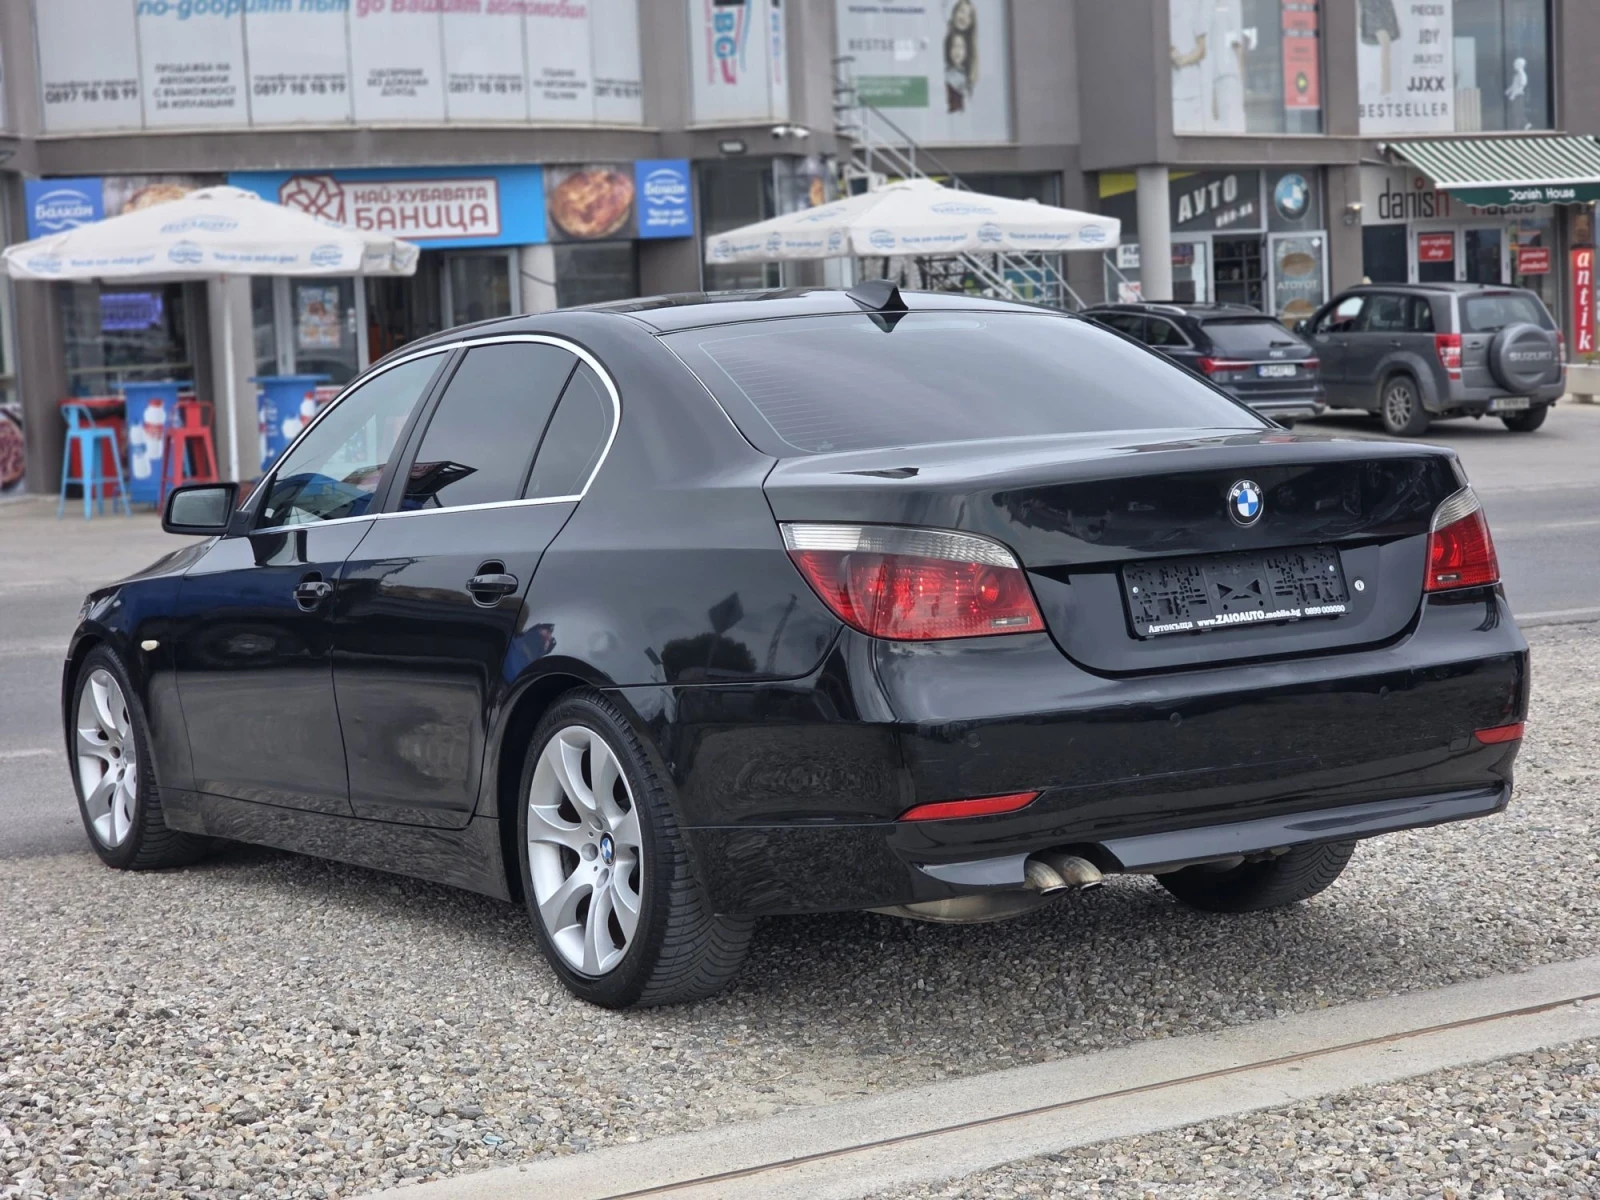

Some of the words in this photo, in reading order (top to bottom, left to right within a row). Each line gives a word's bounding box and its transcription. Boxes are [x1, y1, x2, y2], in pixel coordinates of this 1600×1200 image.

[254, 81, 286, 96] 0897
[290, 81, 306, 95] 98
[310, 81, 326, 95] 98
[330, 80, 346, 94] 99
[1406, 76, 1446, 92] JJXX
[45, 88, 78, 104] 0897
[83, 88, 99, 102] 98
[103, 87, 120, 101] 98
[122, 86, 138, 99] 99
[1358, 102, 1449, 119] BESTSELLER
[353, 185, 488, 204] НАЙ-ХУБАВАТА
[1508, 188, 1543, 201] Danish
[1545, 187, 1576, 199] House
[35, 204, 93, 220] Балкан
[355, 203, 489, 232] БАНИЦА
[1576, 252, 1591, 350] antik
[1508, 350, 1553, 362] SUZUKI
[1149, 621, 1193, 633] Автокъща
